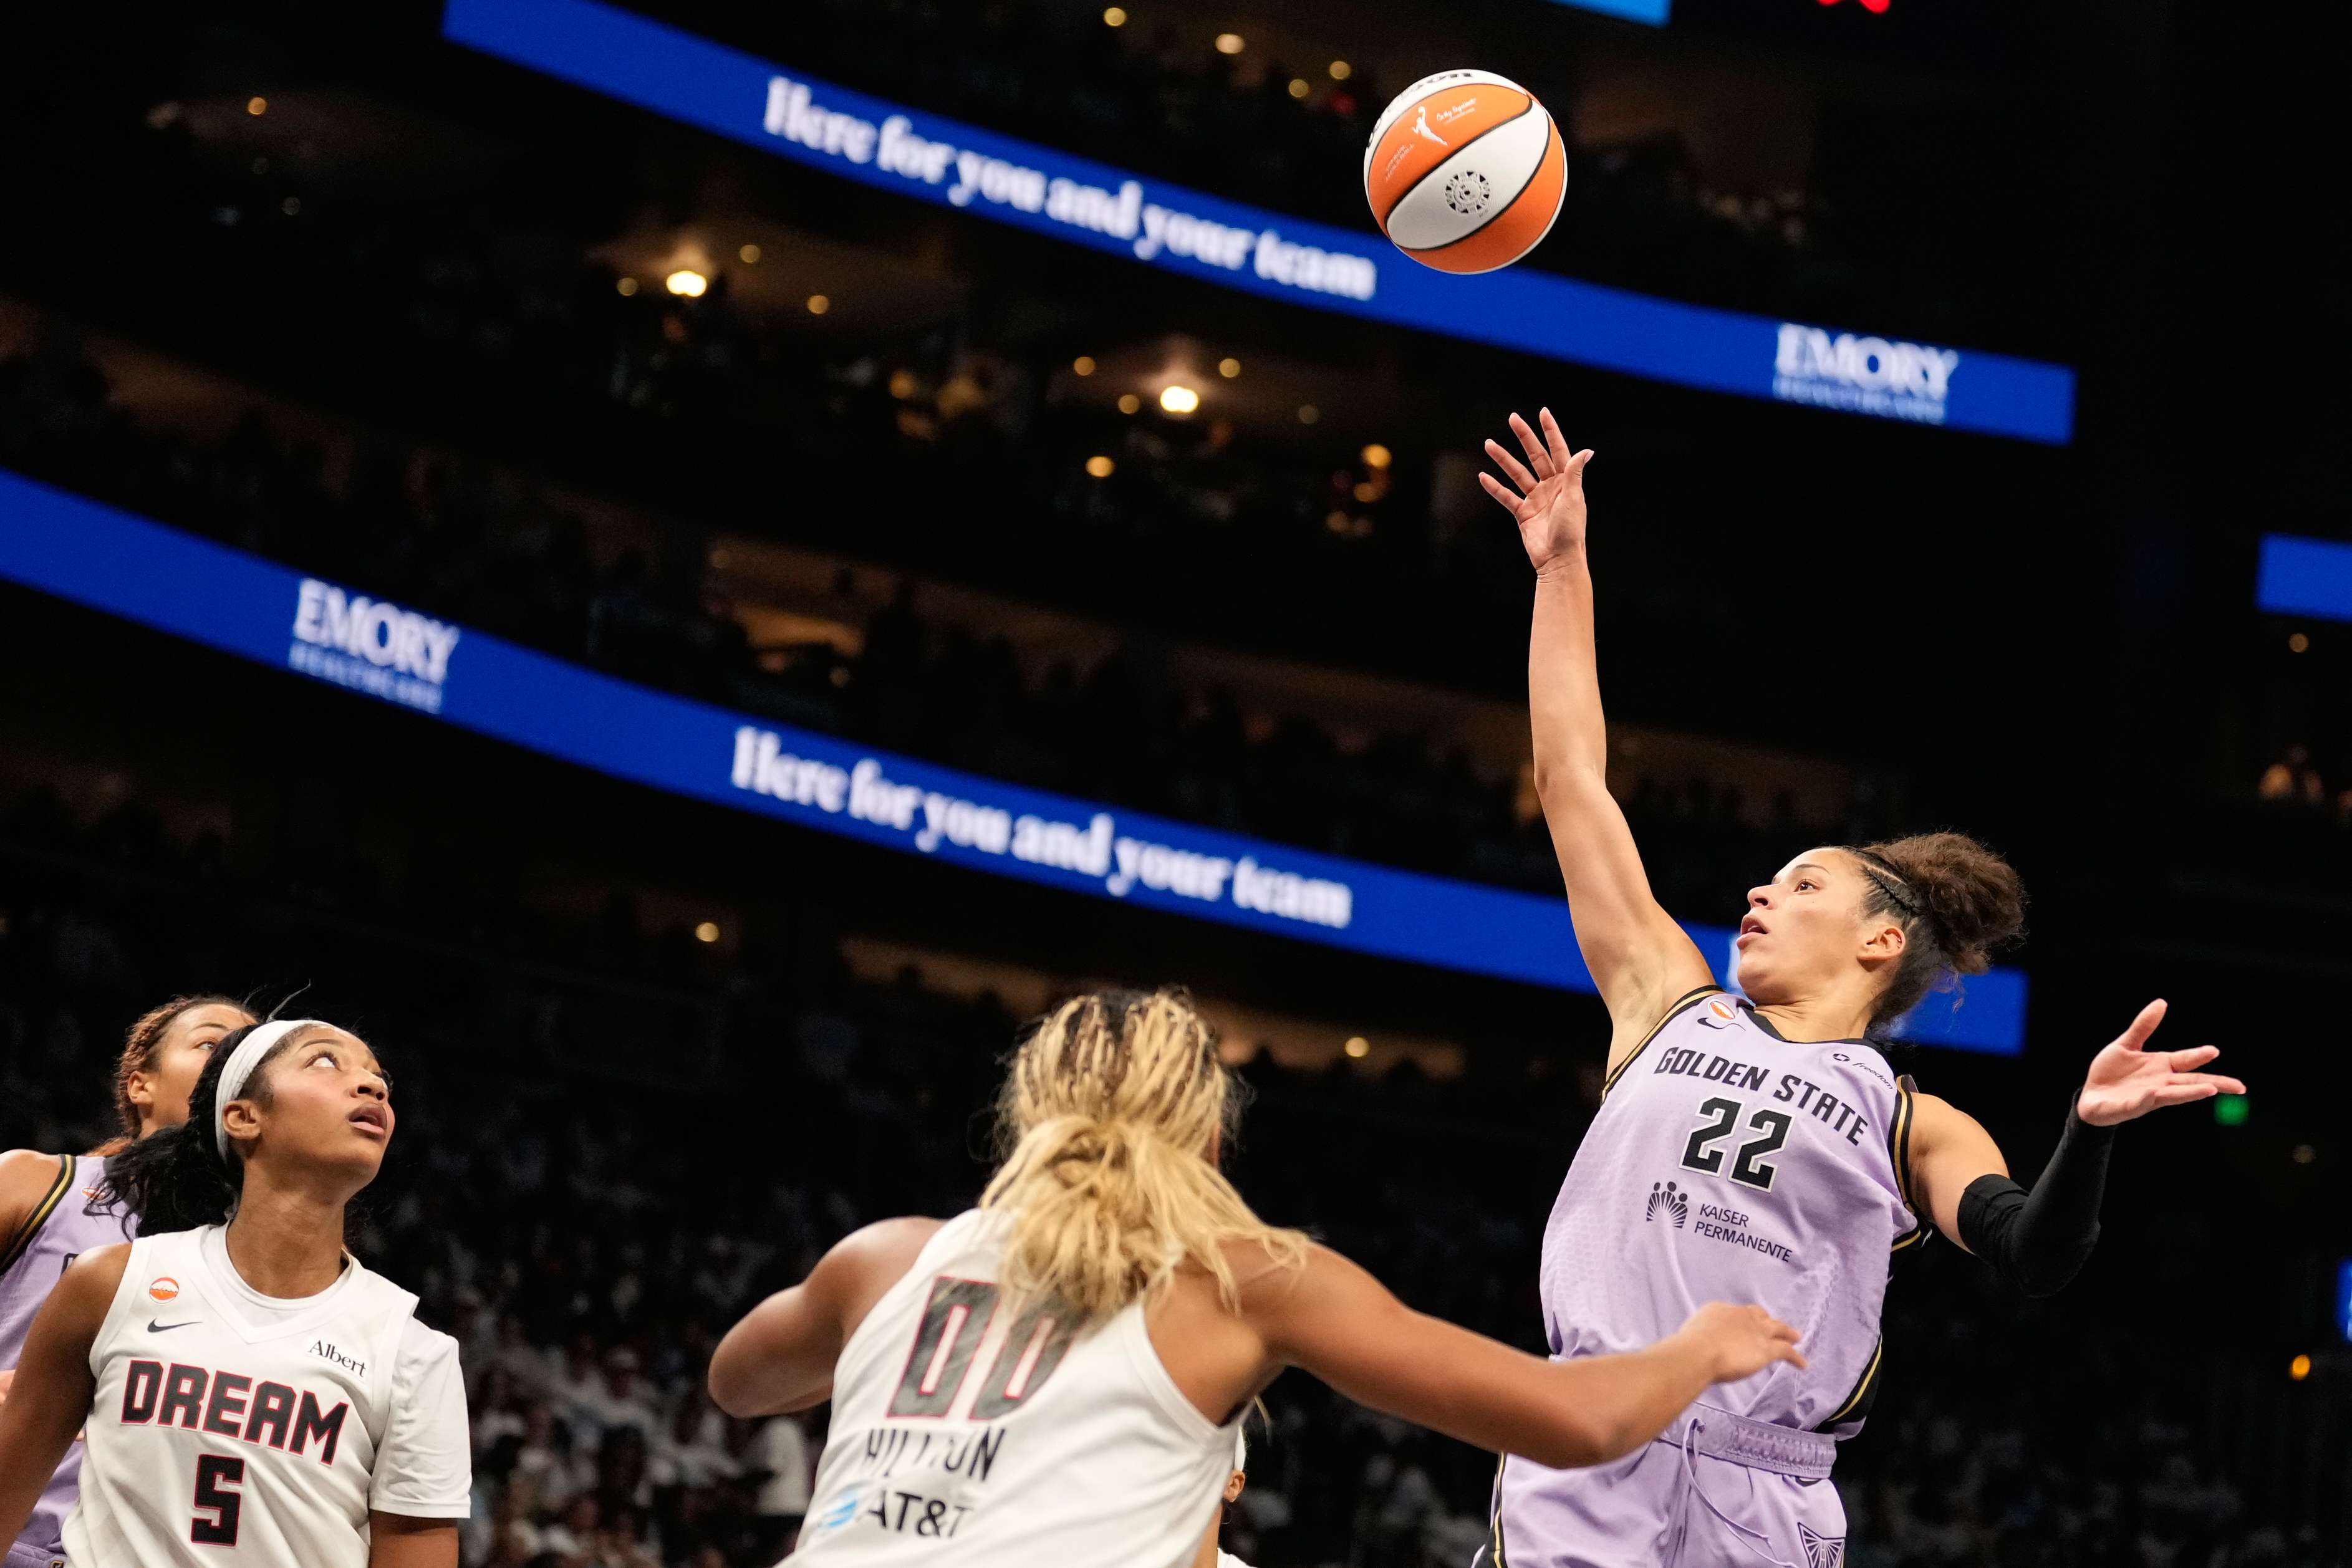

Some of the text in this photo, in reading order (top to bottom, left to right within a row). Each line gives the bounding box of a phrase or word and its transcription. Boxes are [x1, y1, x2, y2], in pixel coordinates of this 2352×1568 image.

[764, 75, 1377, 301] Here for you and your team
[1775, 322, 1959, 402] EMORY
[294, 577, 461, 685] EMORY
[731, 725, 1353, 930] Here for you and your team
[1654, 1047, 1868, 1147] GOLDEN STATE
[1852, 1062, 1893, 1090] freedom
[1679, 1094, 1796, 1193] 22
[1694, 1221, 1793, 1263] PERMANENTE
[1699, 1203, 1750, 1228] KAISER
[307, 1340, 367, 1378] Albert
[886, 1275, 1092, 1421] 00
[120, 1359, 349, 1467] DREAM
[190, 1453, 245, 1547] 5
[858, 1489, 973, 1539] AT&T
